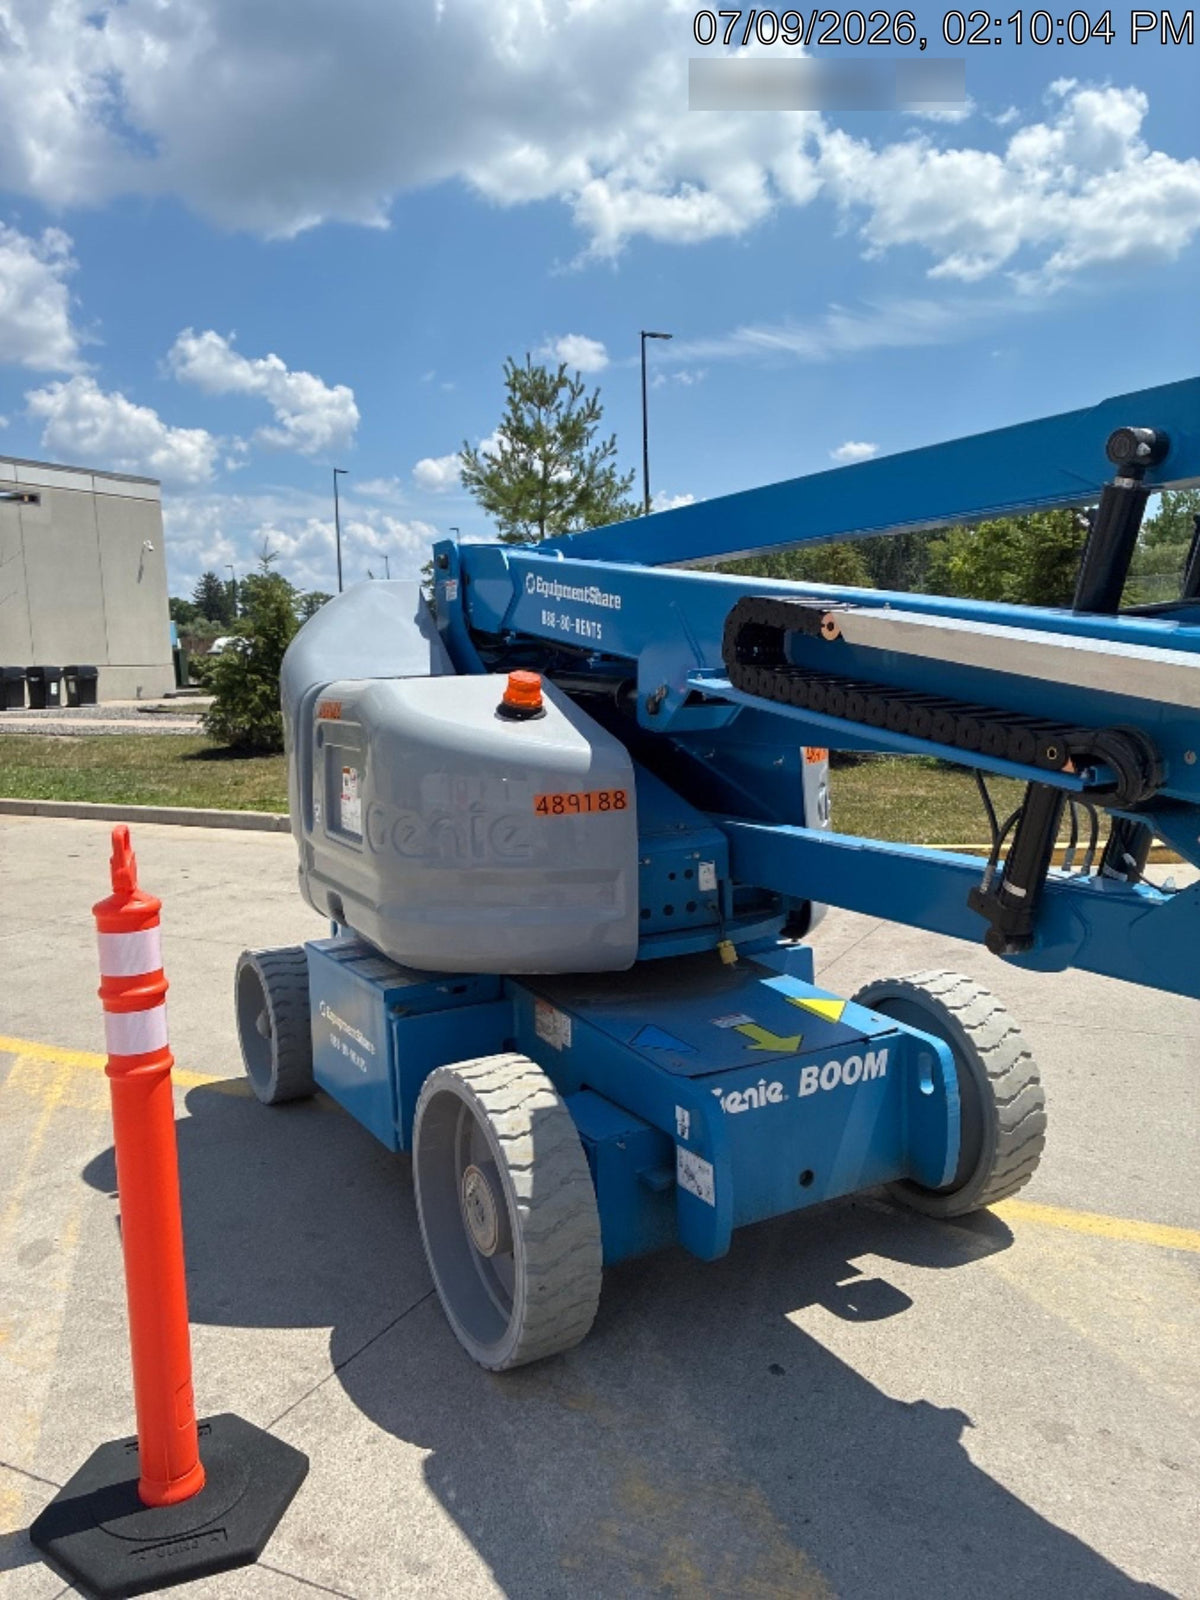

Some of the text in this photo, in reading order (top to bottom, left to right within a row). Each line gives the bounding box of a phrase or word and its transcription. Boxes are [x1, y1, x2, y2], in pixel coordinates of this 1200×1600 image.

[536, 575, 622, 609] EquipmentShare
[536, 790, 627, 815] 489188
[798, 1048, 889, 1098] BOOM
